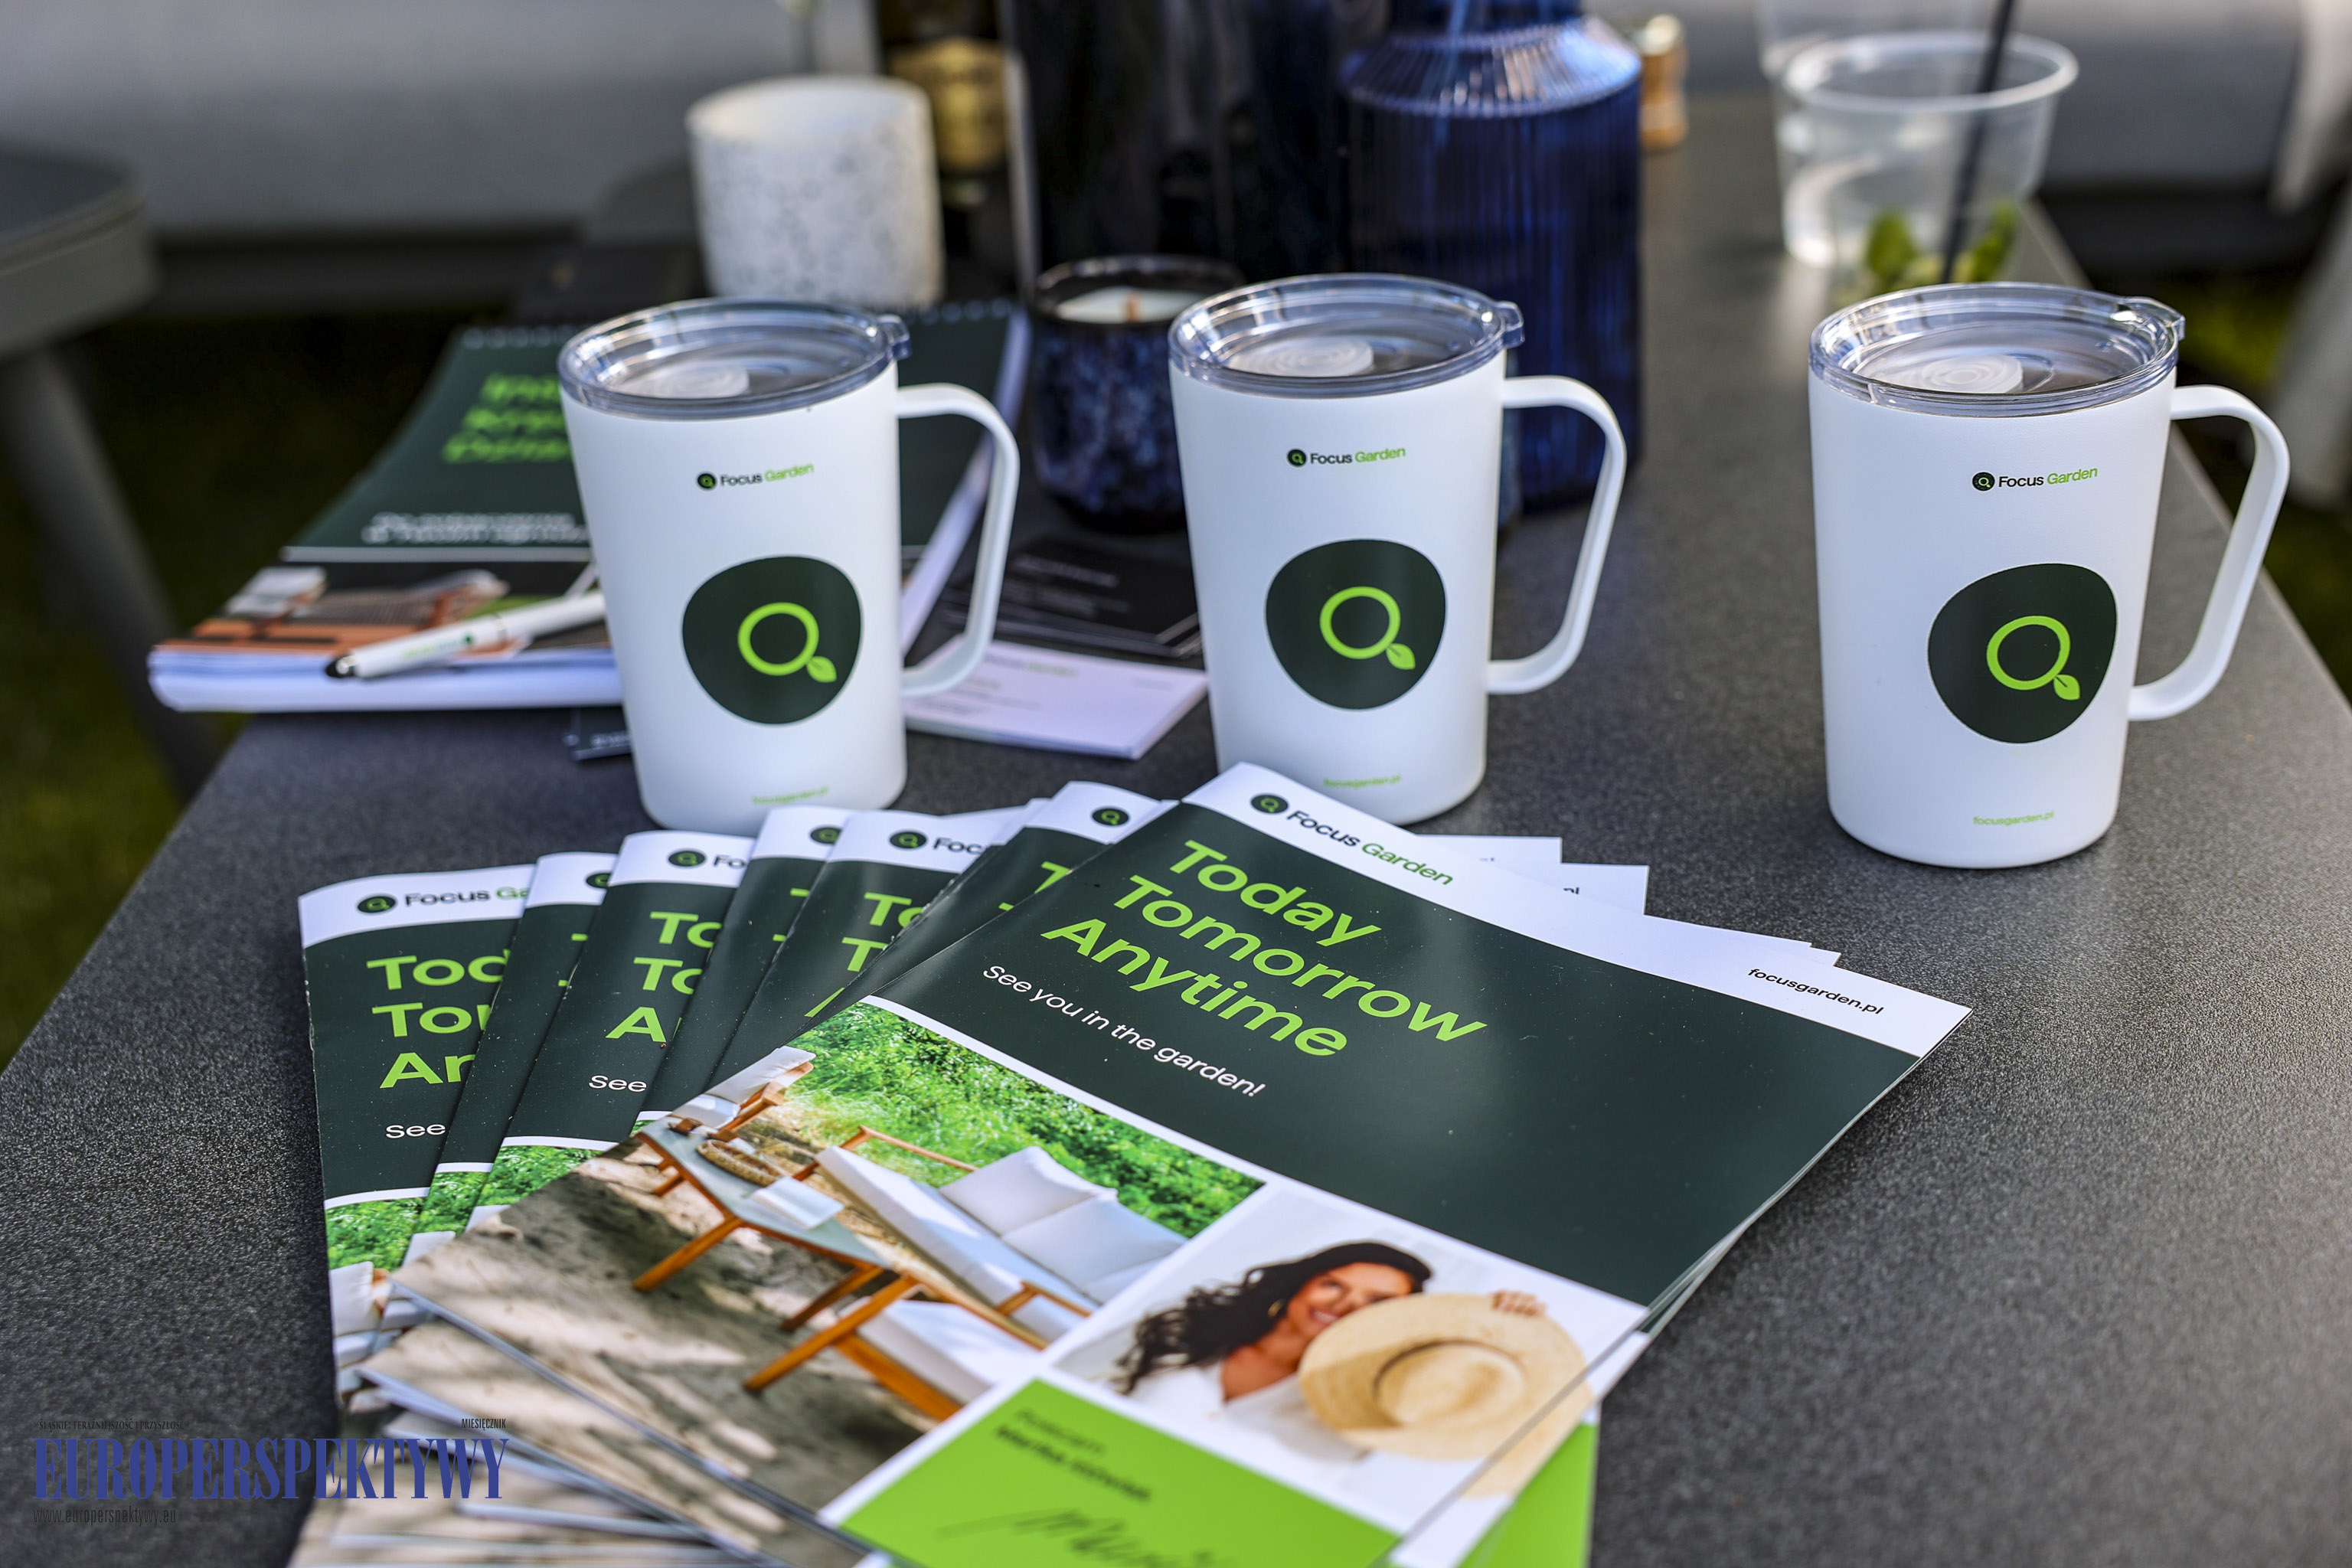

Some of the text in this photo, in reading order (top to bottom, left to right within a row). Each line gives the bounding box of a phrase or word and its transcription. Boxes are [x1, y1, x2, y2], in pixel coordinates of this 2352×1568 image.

[1310, 447, 1406, 464] Focus Garden
[720, 472, 763, 486] Focus
[1998, 467, 2098, 488] Focus Garden
[1286, 810, 1453, 885] Focus Garden
[405, 890, 491, 907] Focus
[1170, 840, 1382, 947] Today
[1113, 875, 1488, 1042] Tomorrow
[1040, 918, 1348, 1057] Anytime
[1747, 968, 1886, 1015] focusgarden.pl
[983, 965, 1266, 1097] See you in the garden!
[588, 1075, 647, 1092] See
[385, 1123, 446, 1139] See
